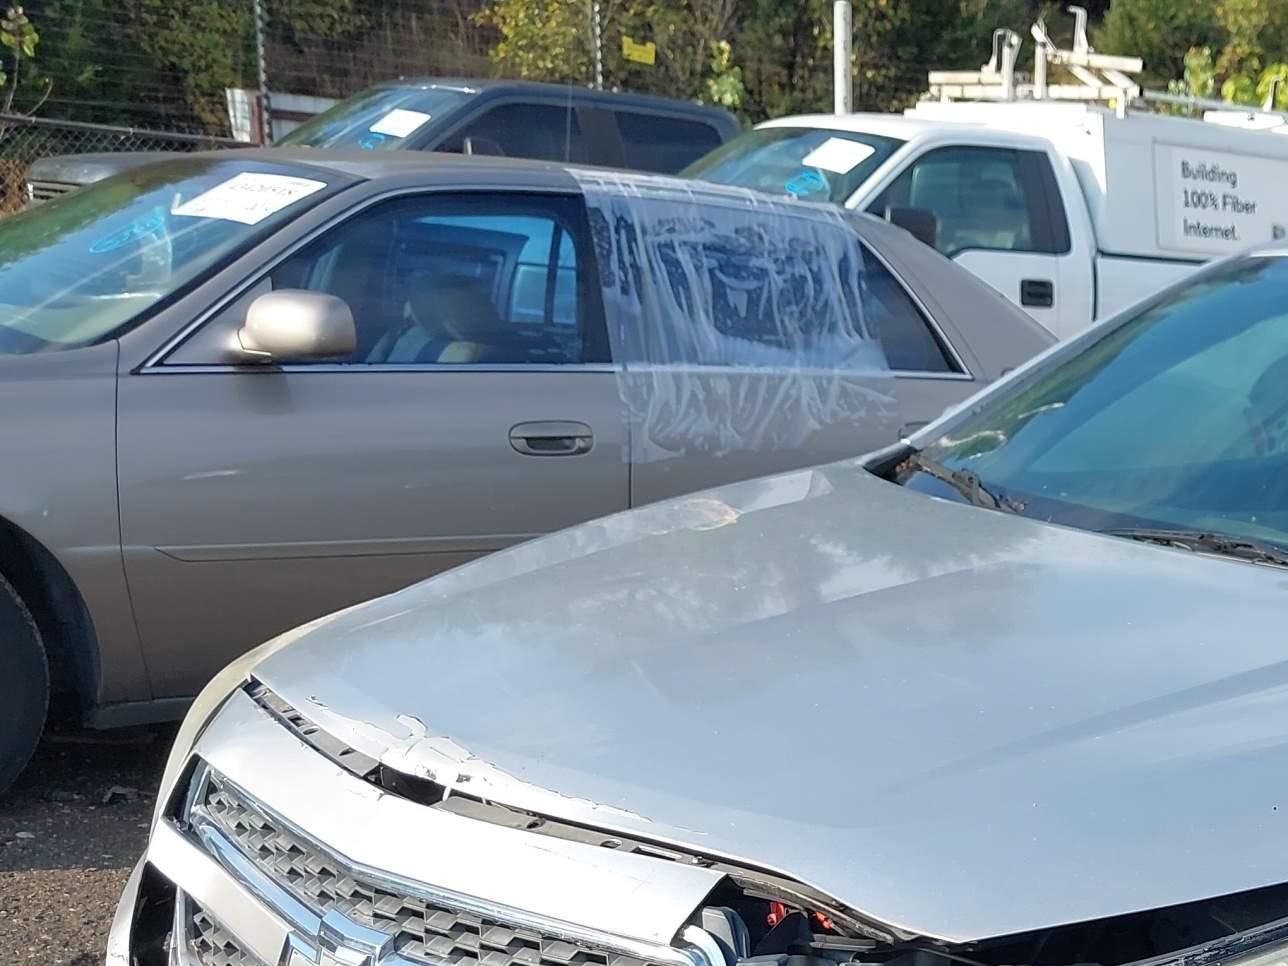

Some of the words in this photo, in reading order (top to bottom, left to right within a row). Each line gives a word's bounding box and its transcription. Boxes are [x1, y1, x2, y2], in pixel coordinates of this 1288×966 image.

[1181, 160, 1238, 189] Building
[1183, 189, 1219, 211] 100%
[1222, 194, 1256, 215] Fiber
[1183, 218, 1241, 241] Internet.
